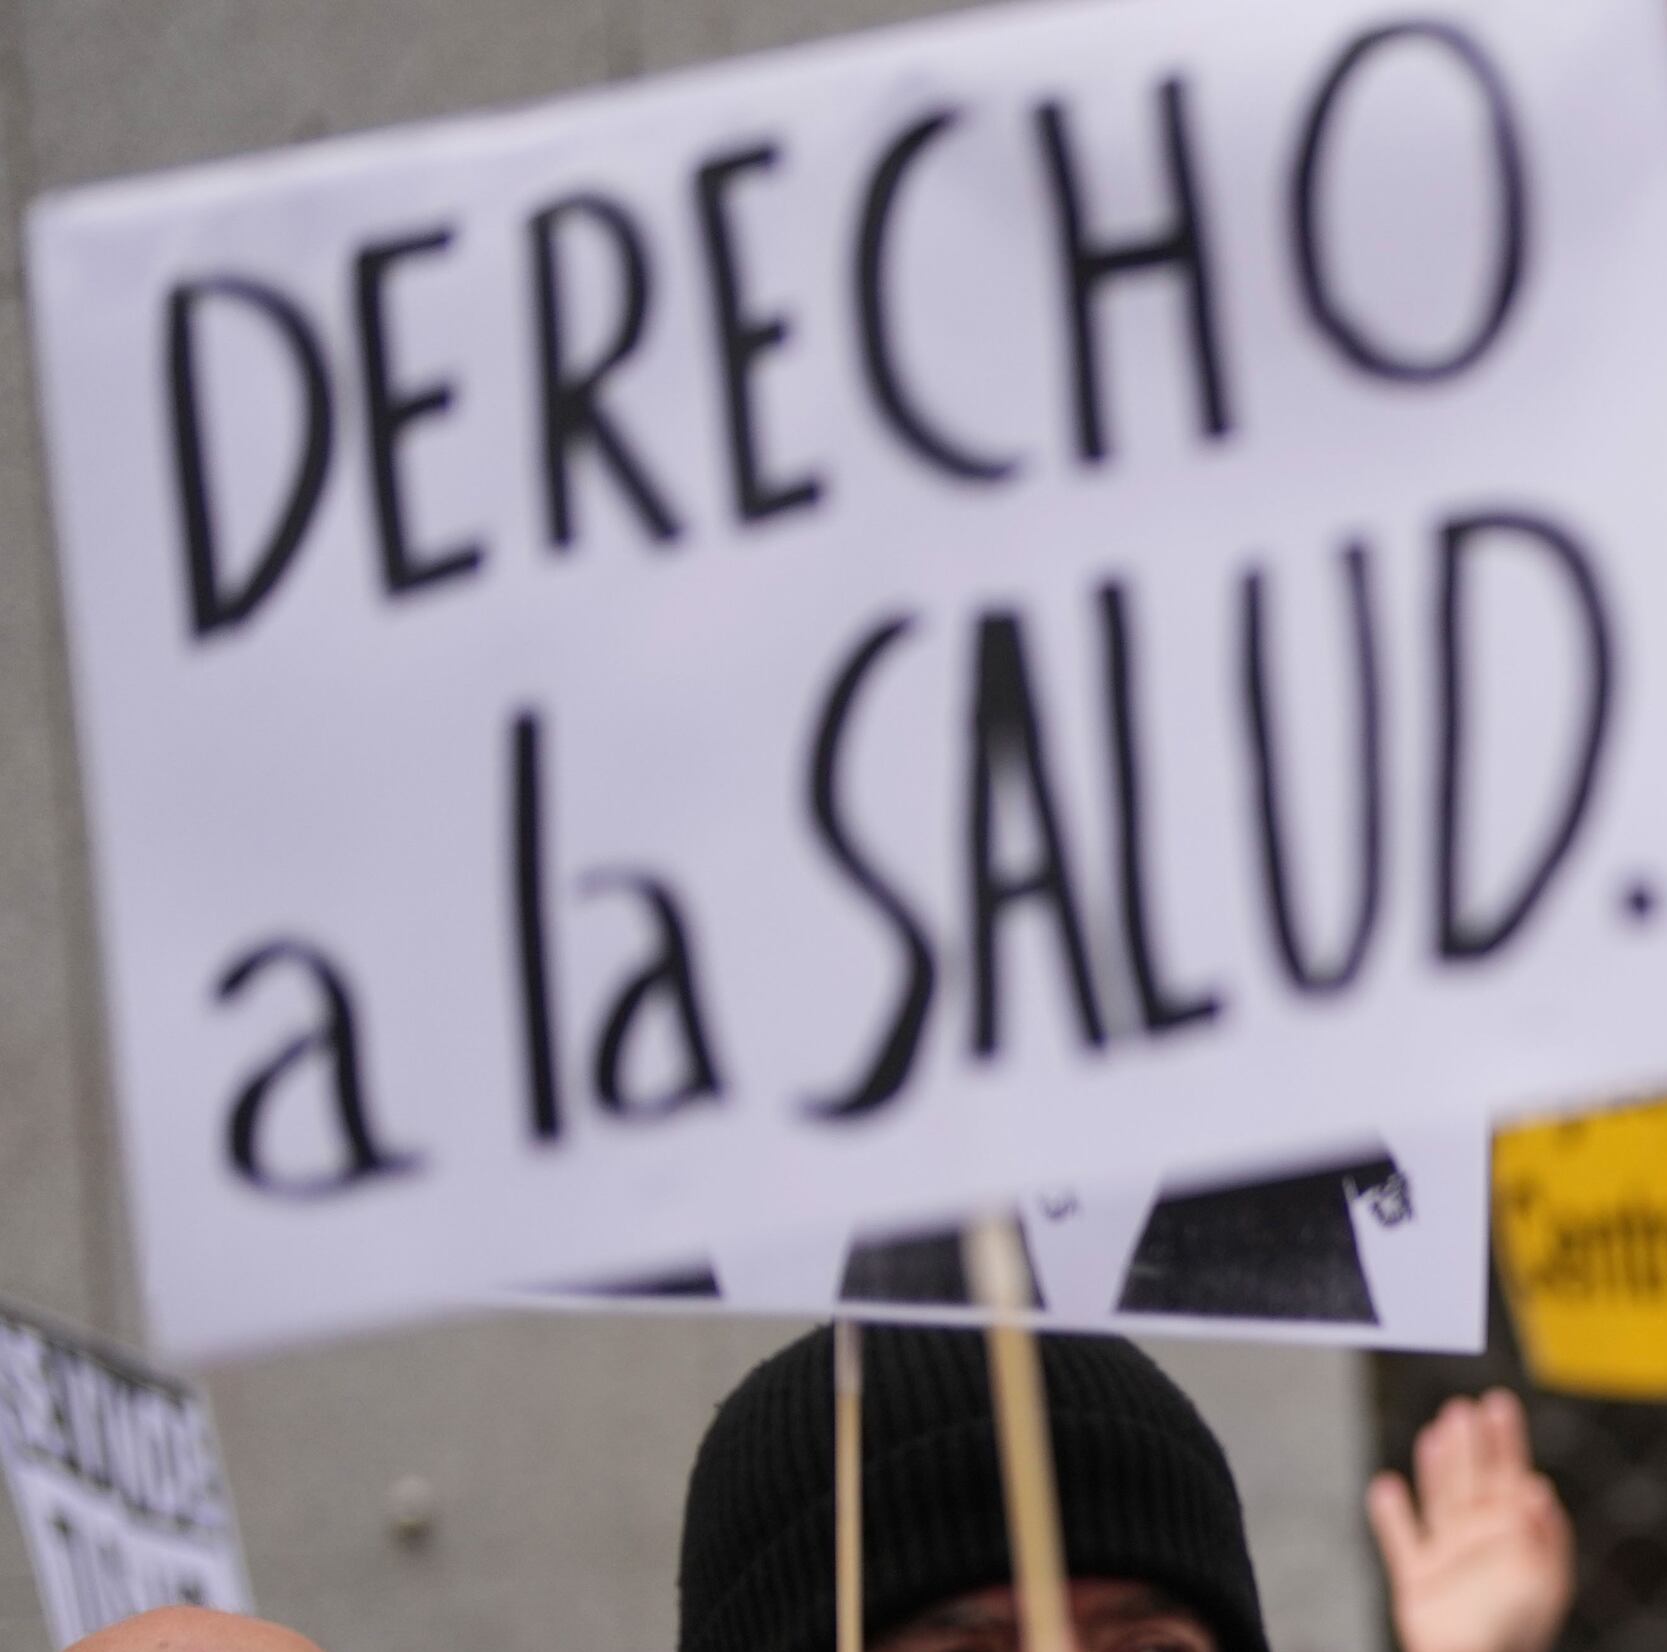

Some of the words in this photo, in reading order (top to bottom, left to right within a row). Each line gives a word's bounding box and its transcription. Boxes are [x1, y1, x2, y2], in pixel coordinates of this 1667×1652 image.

[160, 20, 1534, 647] DERECHO
[212, 937, 420, 1199] a
[505, 705, 730, 1150] la
[800, 508, 1660, 1128] SALUD.
